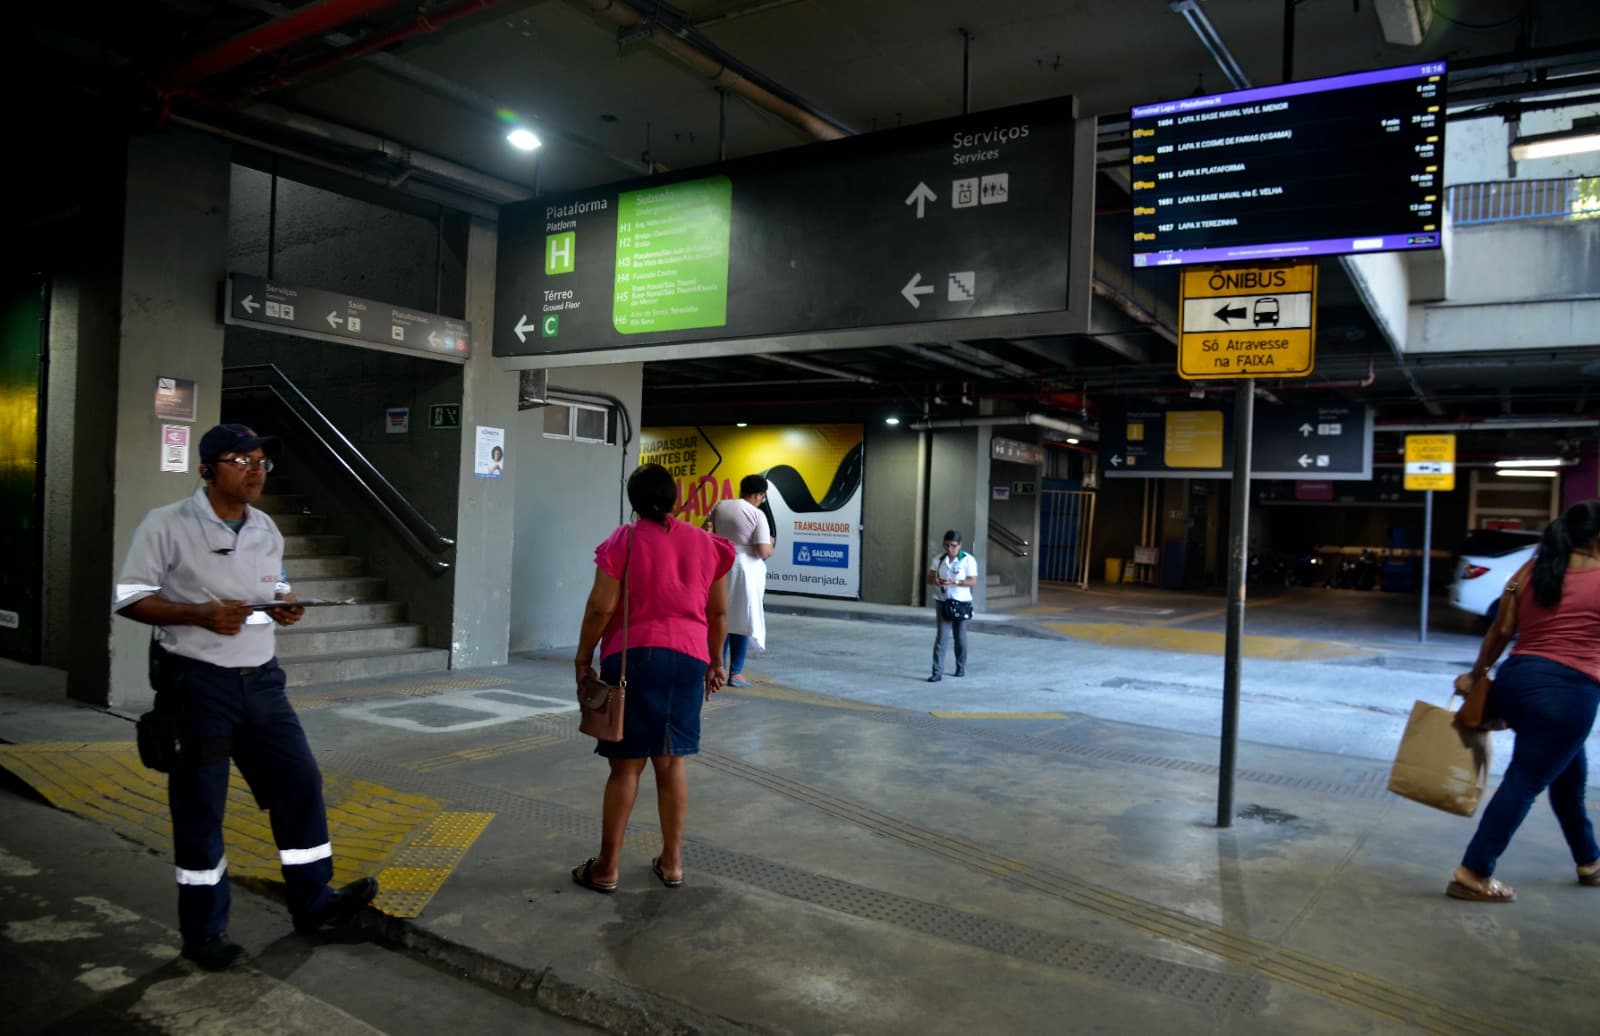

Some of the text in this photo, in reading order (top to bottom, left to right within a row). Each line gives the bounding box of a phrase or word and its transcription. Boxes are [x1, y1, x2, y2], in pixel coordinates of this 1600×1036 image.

[1178, 116, 1195, 125] LAPA
[1201, 112, 1218, 122] BASE
[1219, 110, 1241, 120] NAVAL
[1262, 102, 1289, 113] MENOR
[953, 124, 1030, 150] Serviços
[1178, 142, 1195, 151] LAPA
[1201, 139, 1224, 148] COSME
[1225, 137, 1234, 145] DE
[1235, 134, 1259, 144] FARIAS
[952, 149, 999, 166] Services
[1178, 169, 1195, 178] LAPA
[1201, 163, 1245, 175] PLATAFORMA
[1178, 195, 1195, 204] LAPA
[1201, 192, 1218, 202] BASE
[1219, 190, 1241, 200] NAVAL
[1259, 186, 1283, 196] VELHA
[546, 199, 608, 220] Plataforma
[545, 220, 578, 233] Platform
[1178, 221, 1195, 231] LAPA
[1201, 217, 1238, 228] TEREZINHA
[551, 237, 570, 270] H
[1209, 268, 1287, 291] ÔNIBUS
[544, 289, 574, 302] Térreo
[542, 301, 580, 313] Ground Floor
[545, 316, 557, 335] C
[1202, 338, 1289, 353] Só Atravesse
[1214, 354, 1275, 367] na FAIXA
[641, 450, 697, 465] LIMITES DE
[794, 521, 850, 533] TRANSALVADOR
[812, 549, 844, 559] SALVADOR
[782, 573, 798, 582] em
[800, 573, 848, 587] laranjada.
